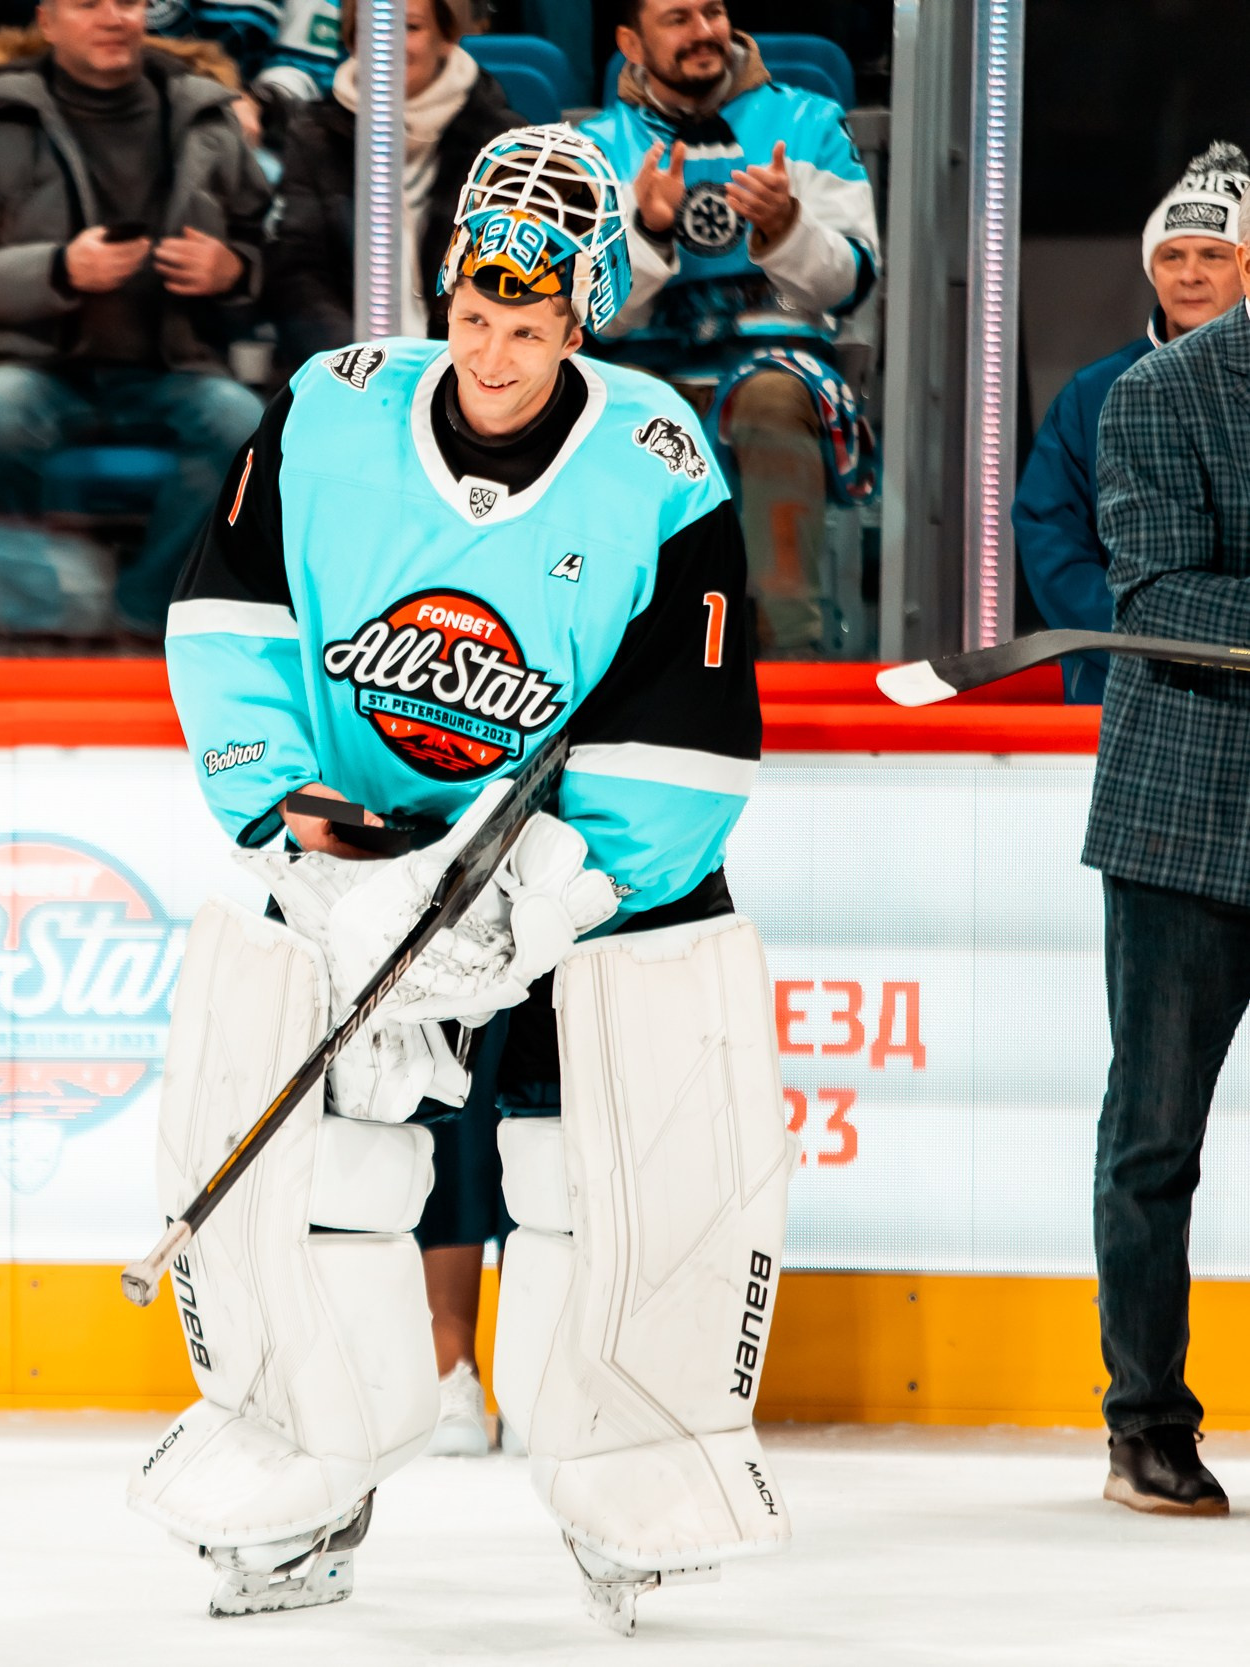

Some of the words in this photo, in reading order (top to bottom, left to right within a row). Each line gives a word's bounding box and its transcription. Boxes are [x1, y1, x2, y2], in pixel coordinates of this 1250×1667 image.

[478, 215, 547, 275] 99
[228, 449, 253, 525] 1
[417, 604, 497, 640] FONBET
[703, 592, 727, 667] 1
[324, 621, 557, 728] All-Star
[368, 694, 388, 708] ST.
[392, 698, 473, 734] PETERSBURG
[483, 729, 512, 745] 2023
[203, 741, 265, 775] Bobrov
[774, 979, 926, 1071] ЕЗД
[166, 1215, 212, 1372] BAUE
[143, 1424, 184, 1477] MACH
[745, 1461, 778, 1516] MACH
